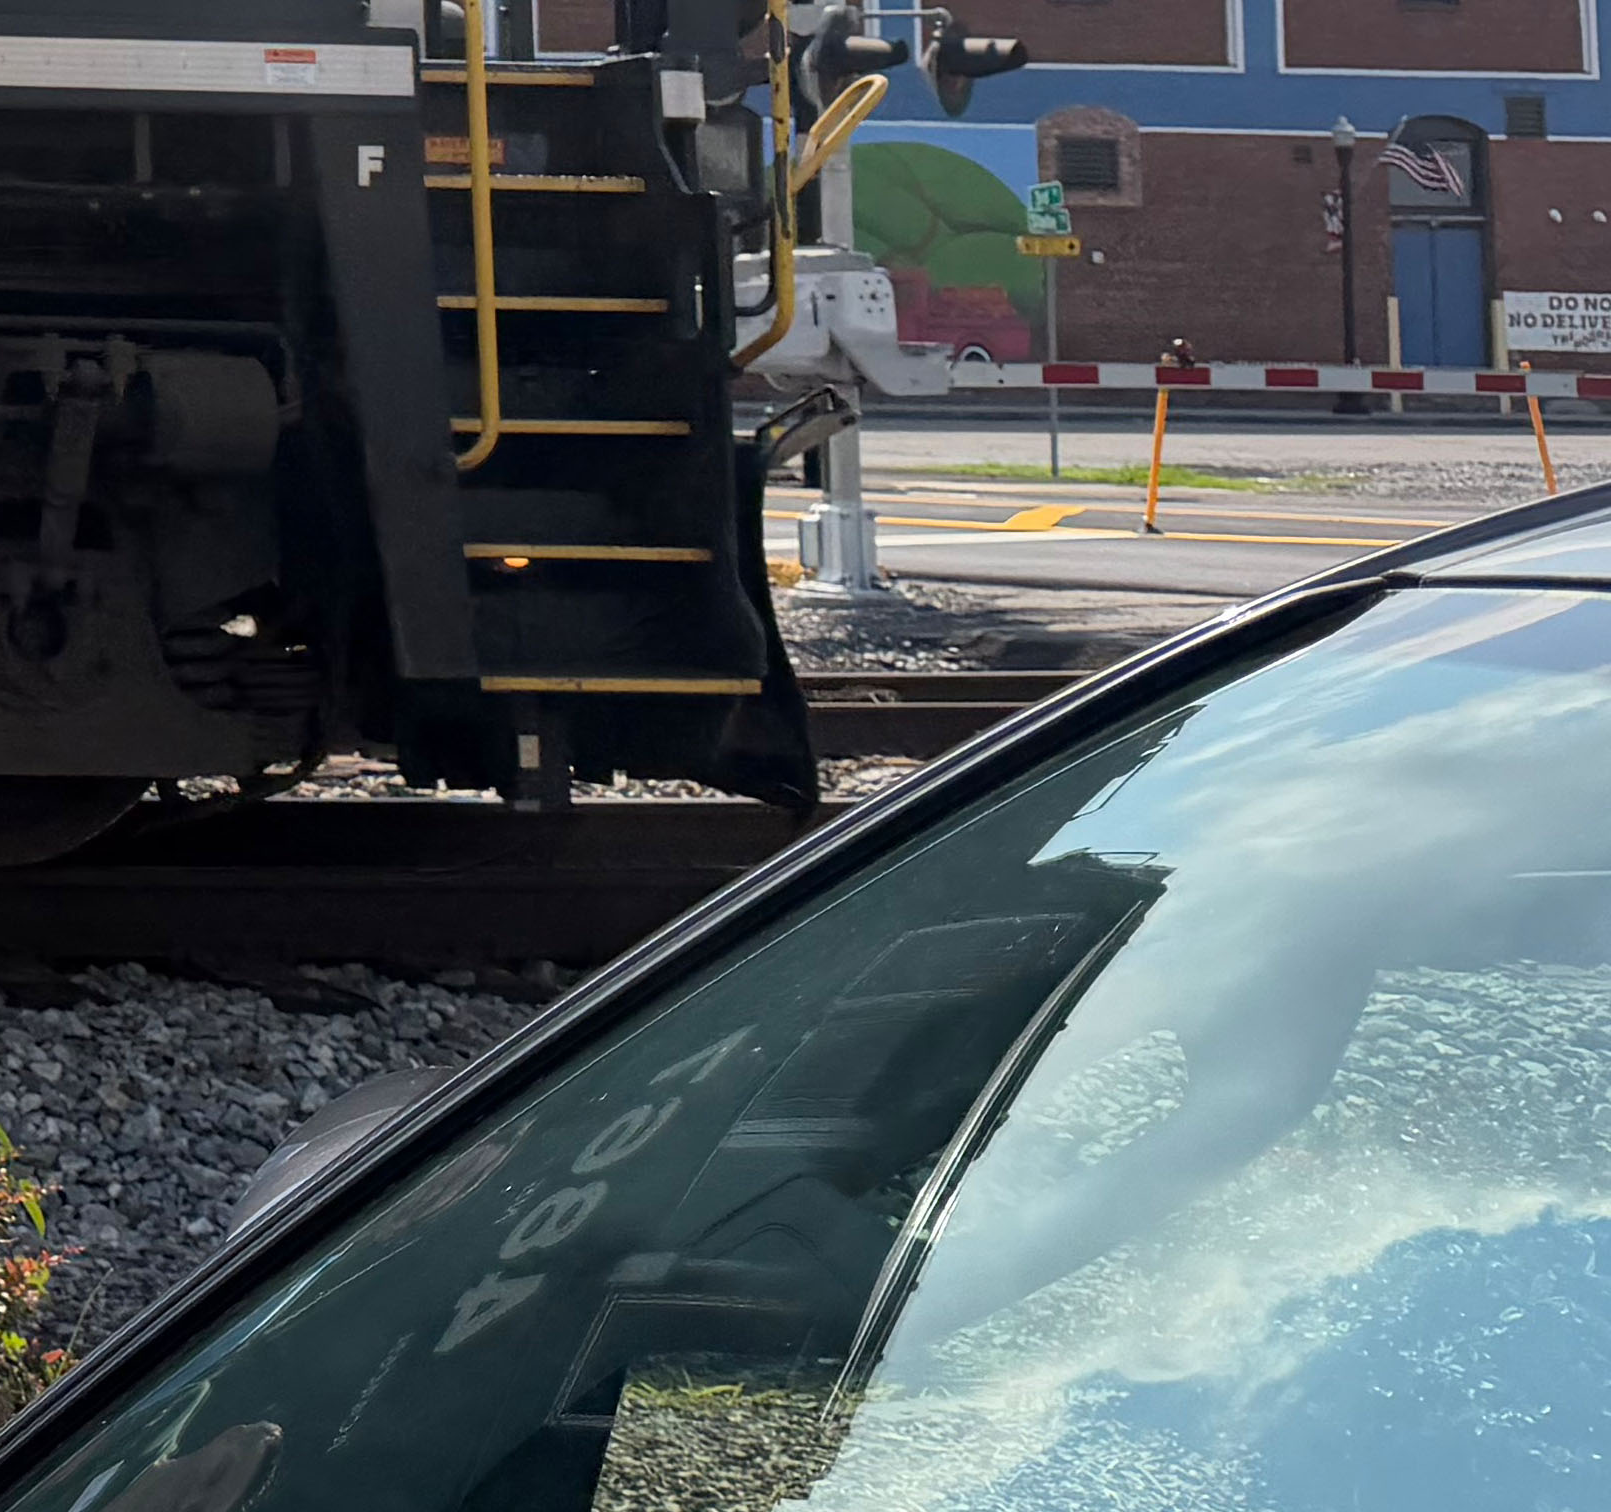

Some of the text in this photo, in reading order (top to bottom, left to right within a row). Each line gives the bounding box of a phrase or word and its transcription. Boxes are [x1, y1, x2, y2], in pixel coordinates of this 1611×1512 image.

[358, 145, 385, 187] F
[1548, 295, 1579, 311] DO
[1508, 311, 1538, 328] NO
